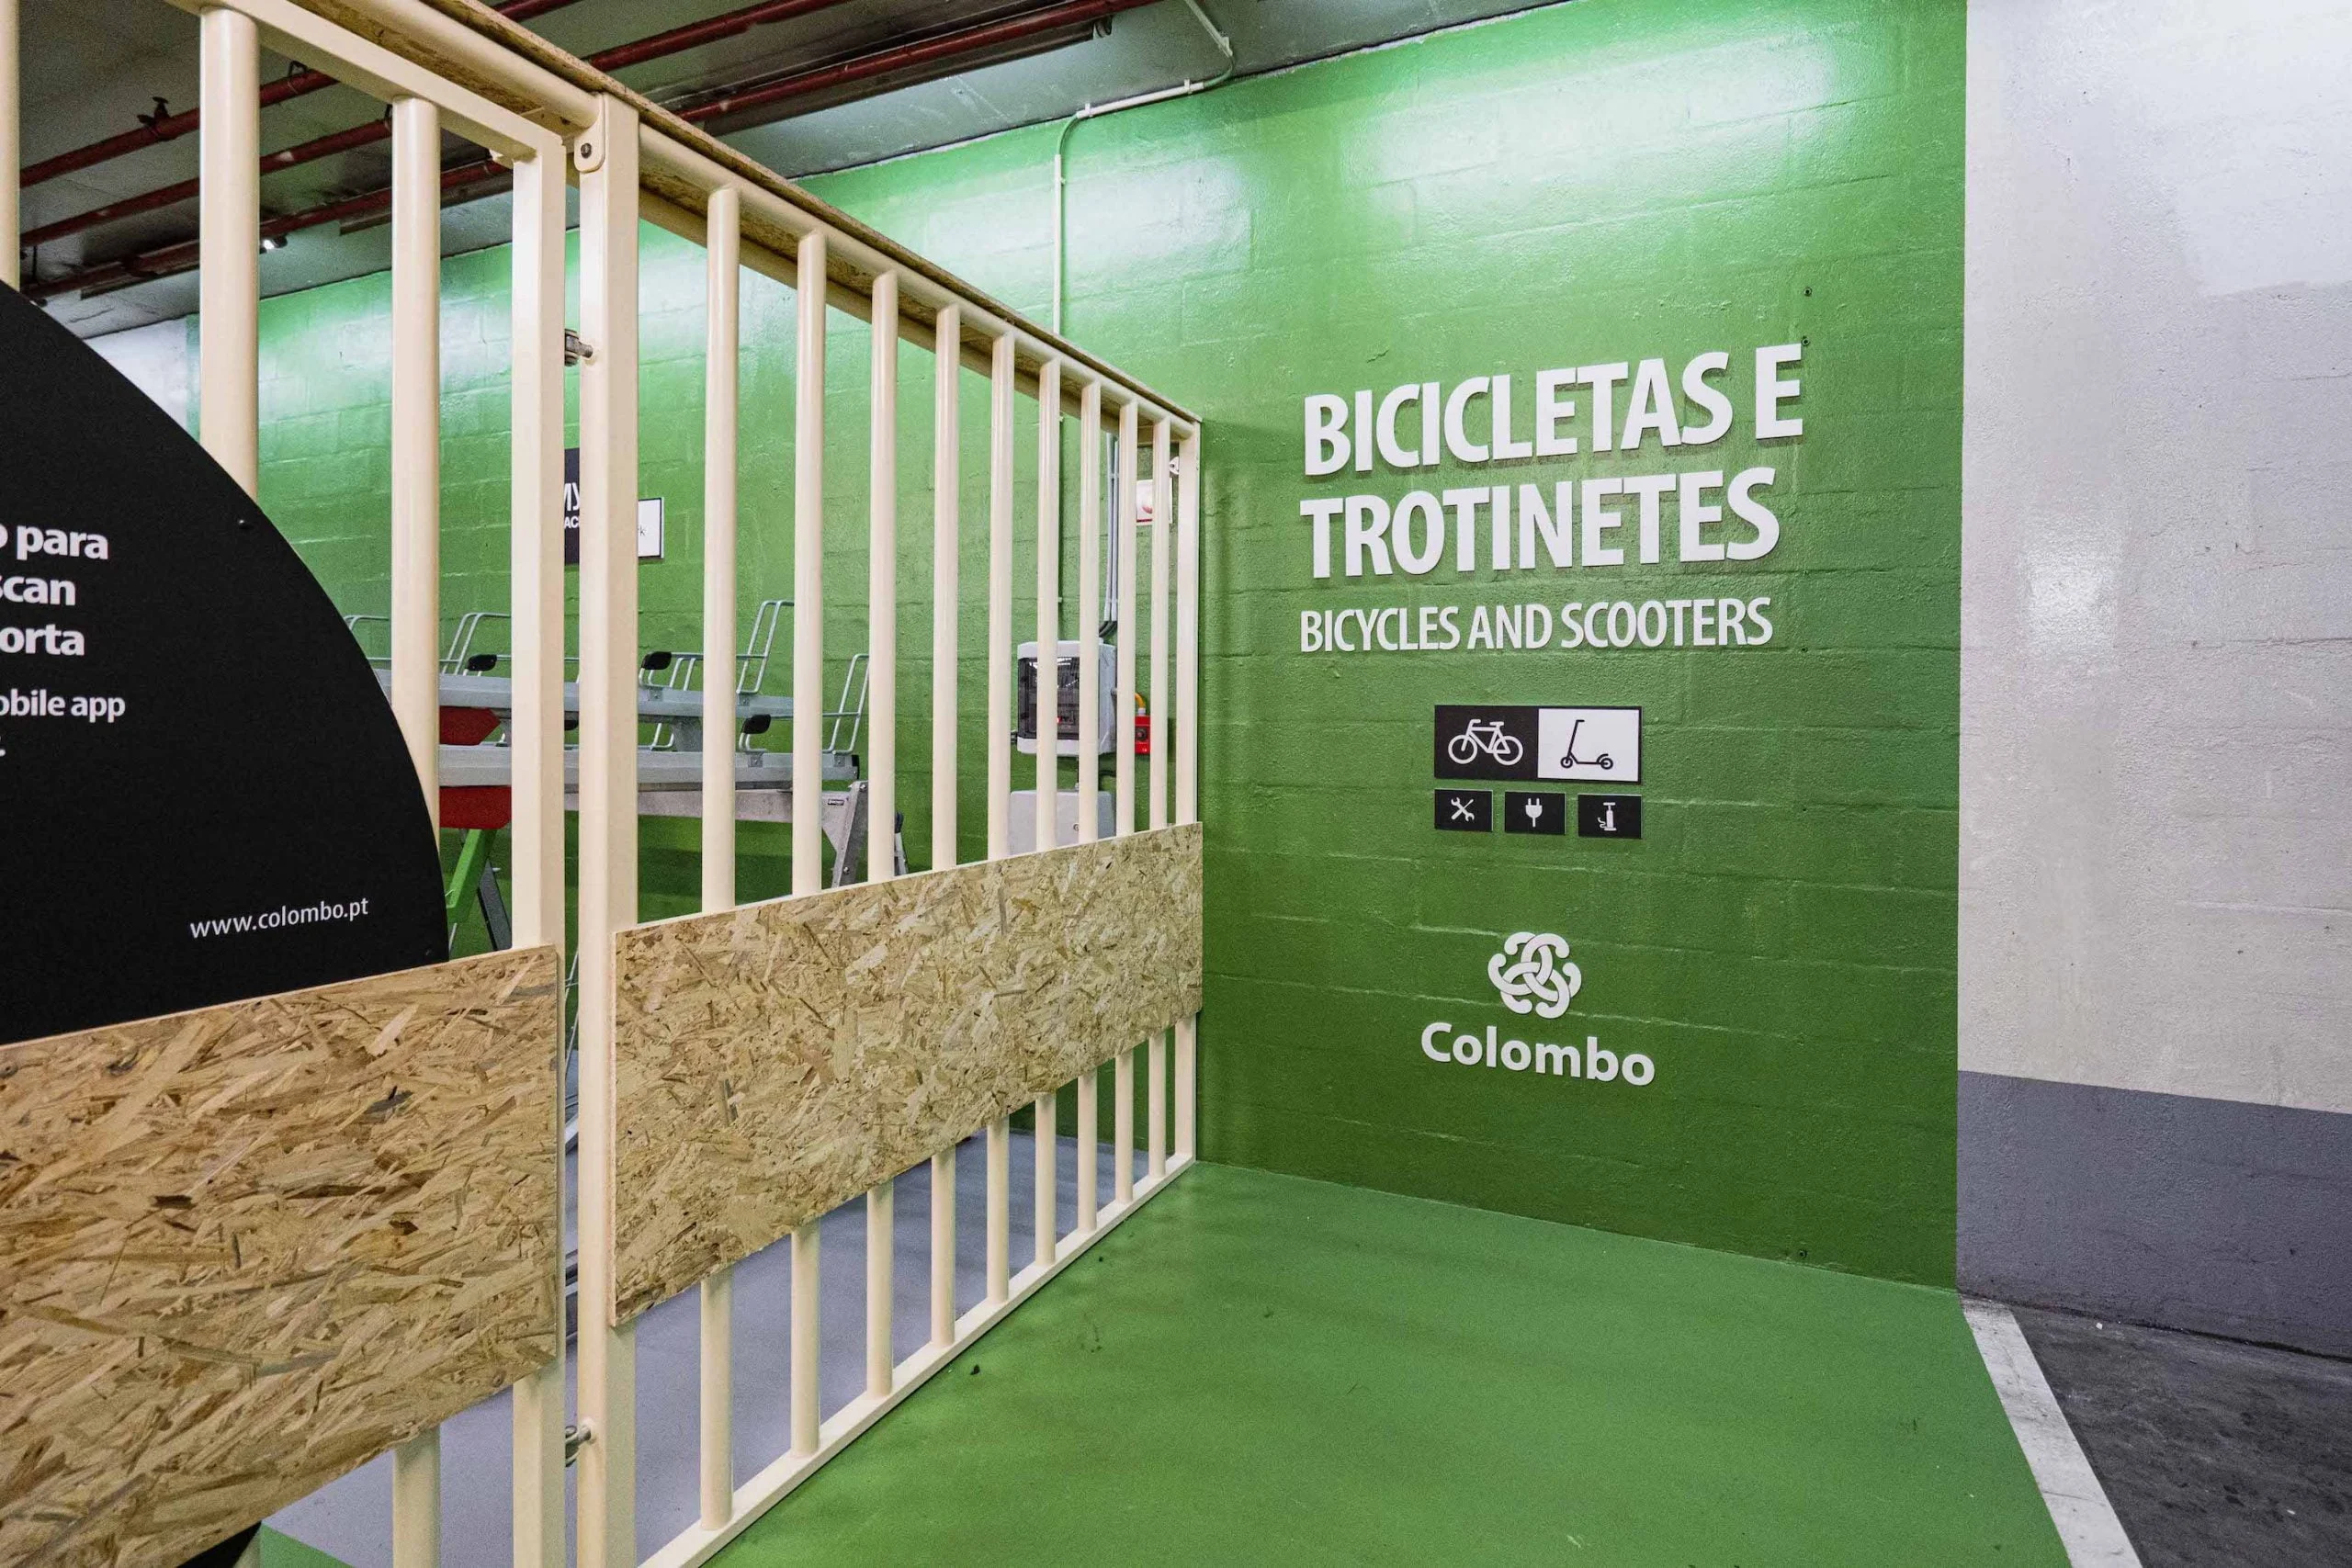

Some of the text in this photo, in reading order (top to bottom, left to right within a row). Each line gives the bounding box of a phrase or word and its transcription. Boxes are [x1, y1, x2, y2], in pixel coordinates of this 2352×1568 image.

[1304, 343, 1804, 476] BICICLETAS E
[17, 525, 108, 561] para
[1299, 467, 1780, 579] TROTINETES
[0, 576, 75, 606] can
[1300, 597, 1773, 652] BICYCLES AND SCOOTERS
[70, 696, 126, 724] app
[189, 897, 368, 939] www.colombo.pt
[1421, 1021, 1655, 1087] Colombo
